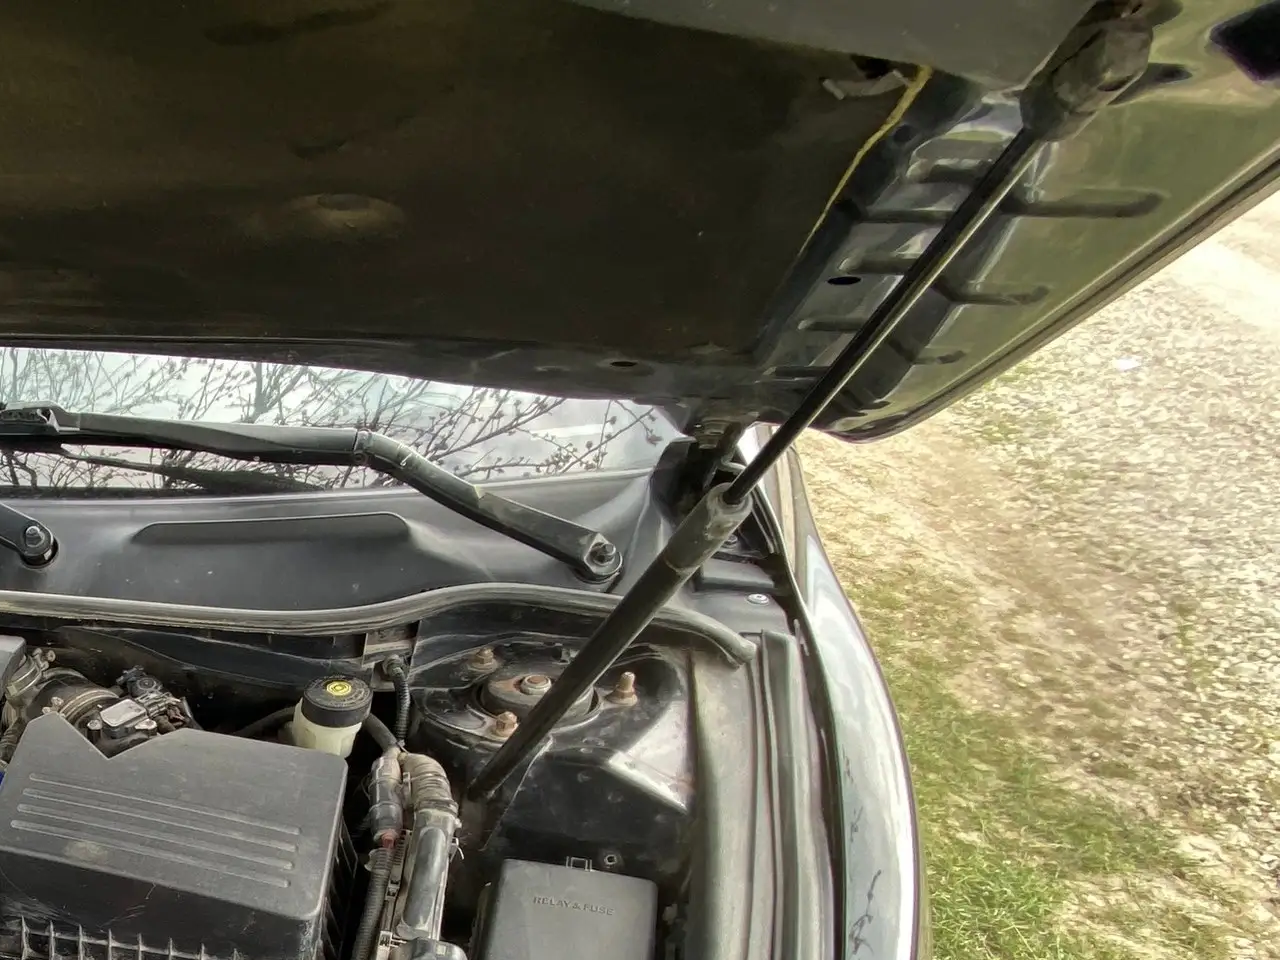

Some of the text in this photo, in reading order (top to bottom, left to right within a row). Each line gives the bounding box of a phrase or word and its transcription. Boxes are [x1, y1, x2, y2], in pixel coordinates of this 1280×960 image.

[533, 895, 615, 916] RELAY & FUSE
